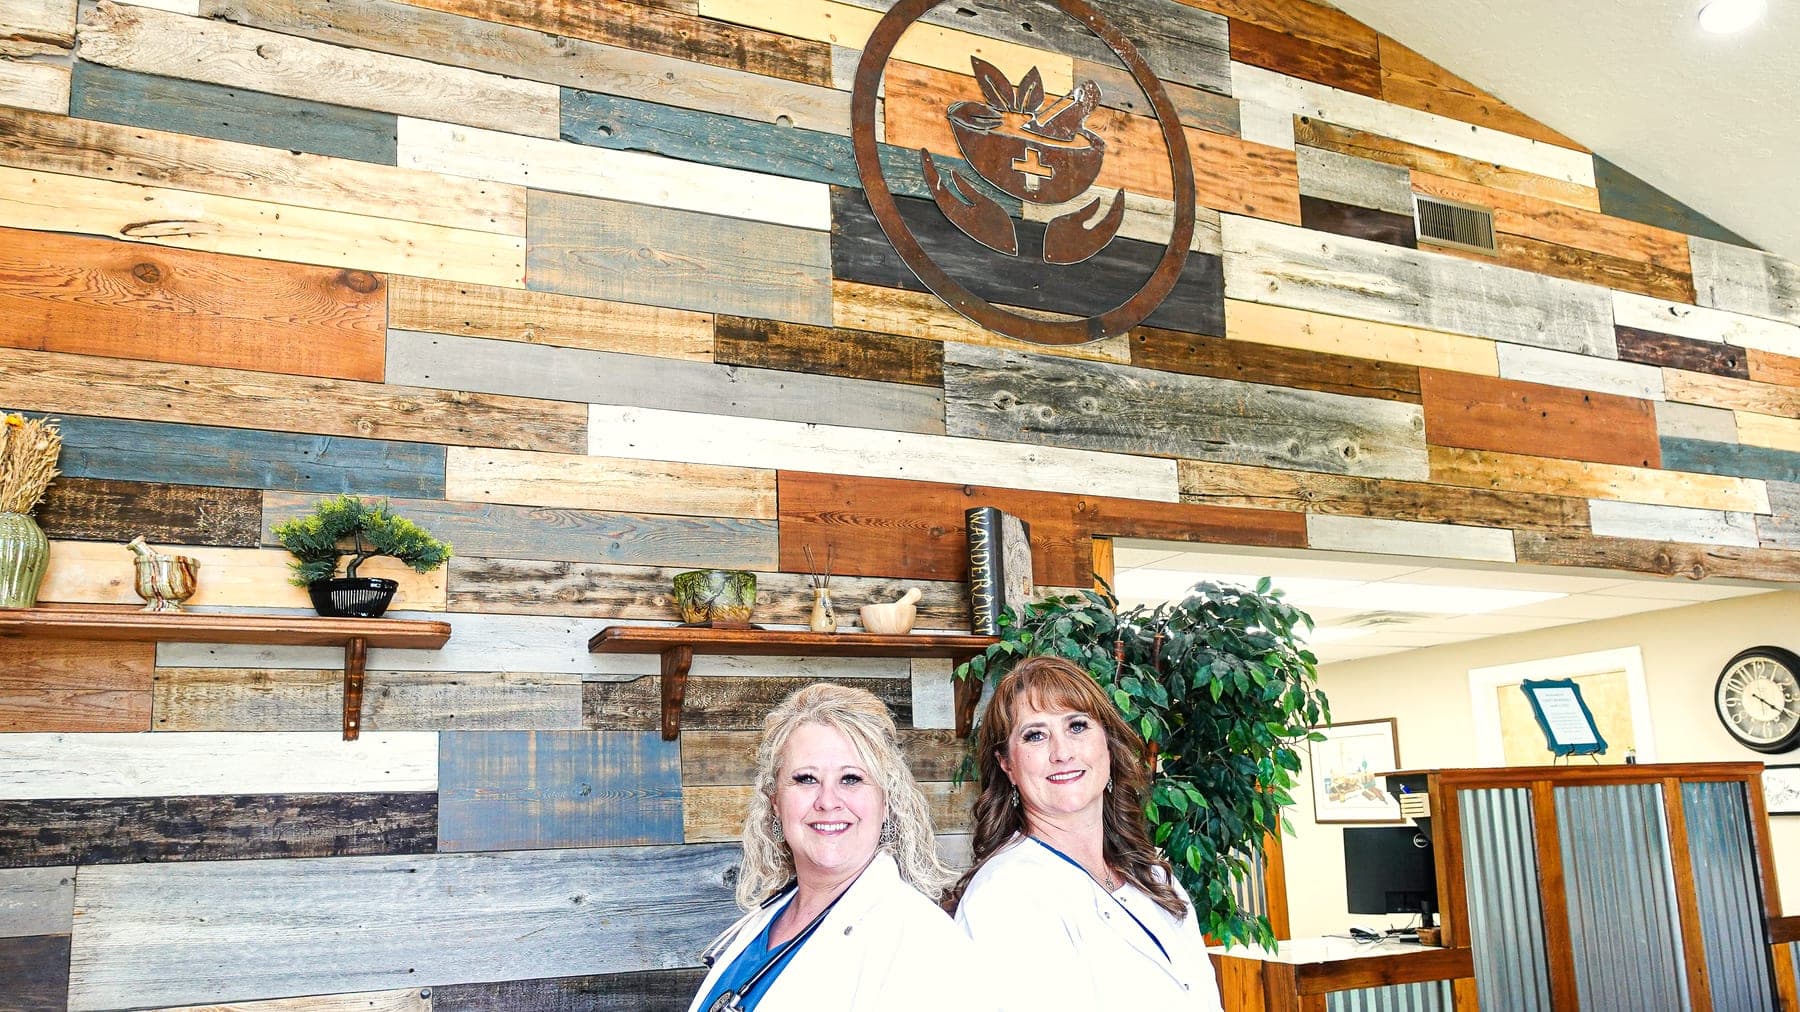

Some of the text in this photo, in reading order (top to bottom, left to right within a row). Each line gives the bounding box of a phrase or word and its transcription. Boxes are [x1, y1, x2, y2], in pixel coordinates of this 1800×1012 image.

[969, 507, 994, 635] WANDERLUST
[1736, 666, 1755, 684] 11
[1751, 660, 1768, 680] 12
[1770, 664, 1779, 680] 1
[1727, 679, 1745, 693] 10
[1777, 677, 1795, 691] 2
[1726, 697, 1743, 707] 9
[1732, 711, 1747, 724] 8
